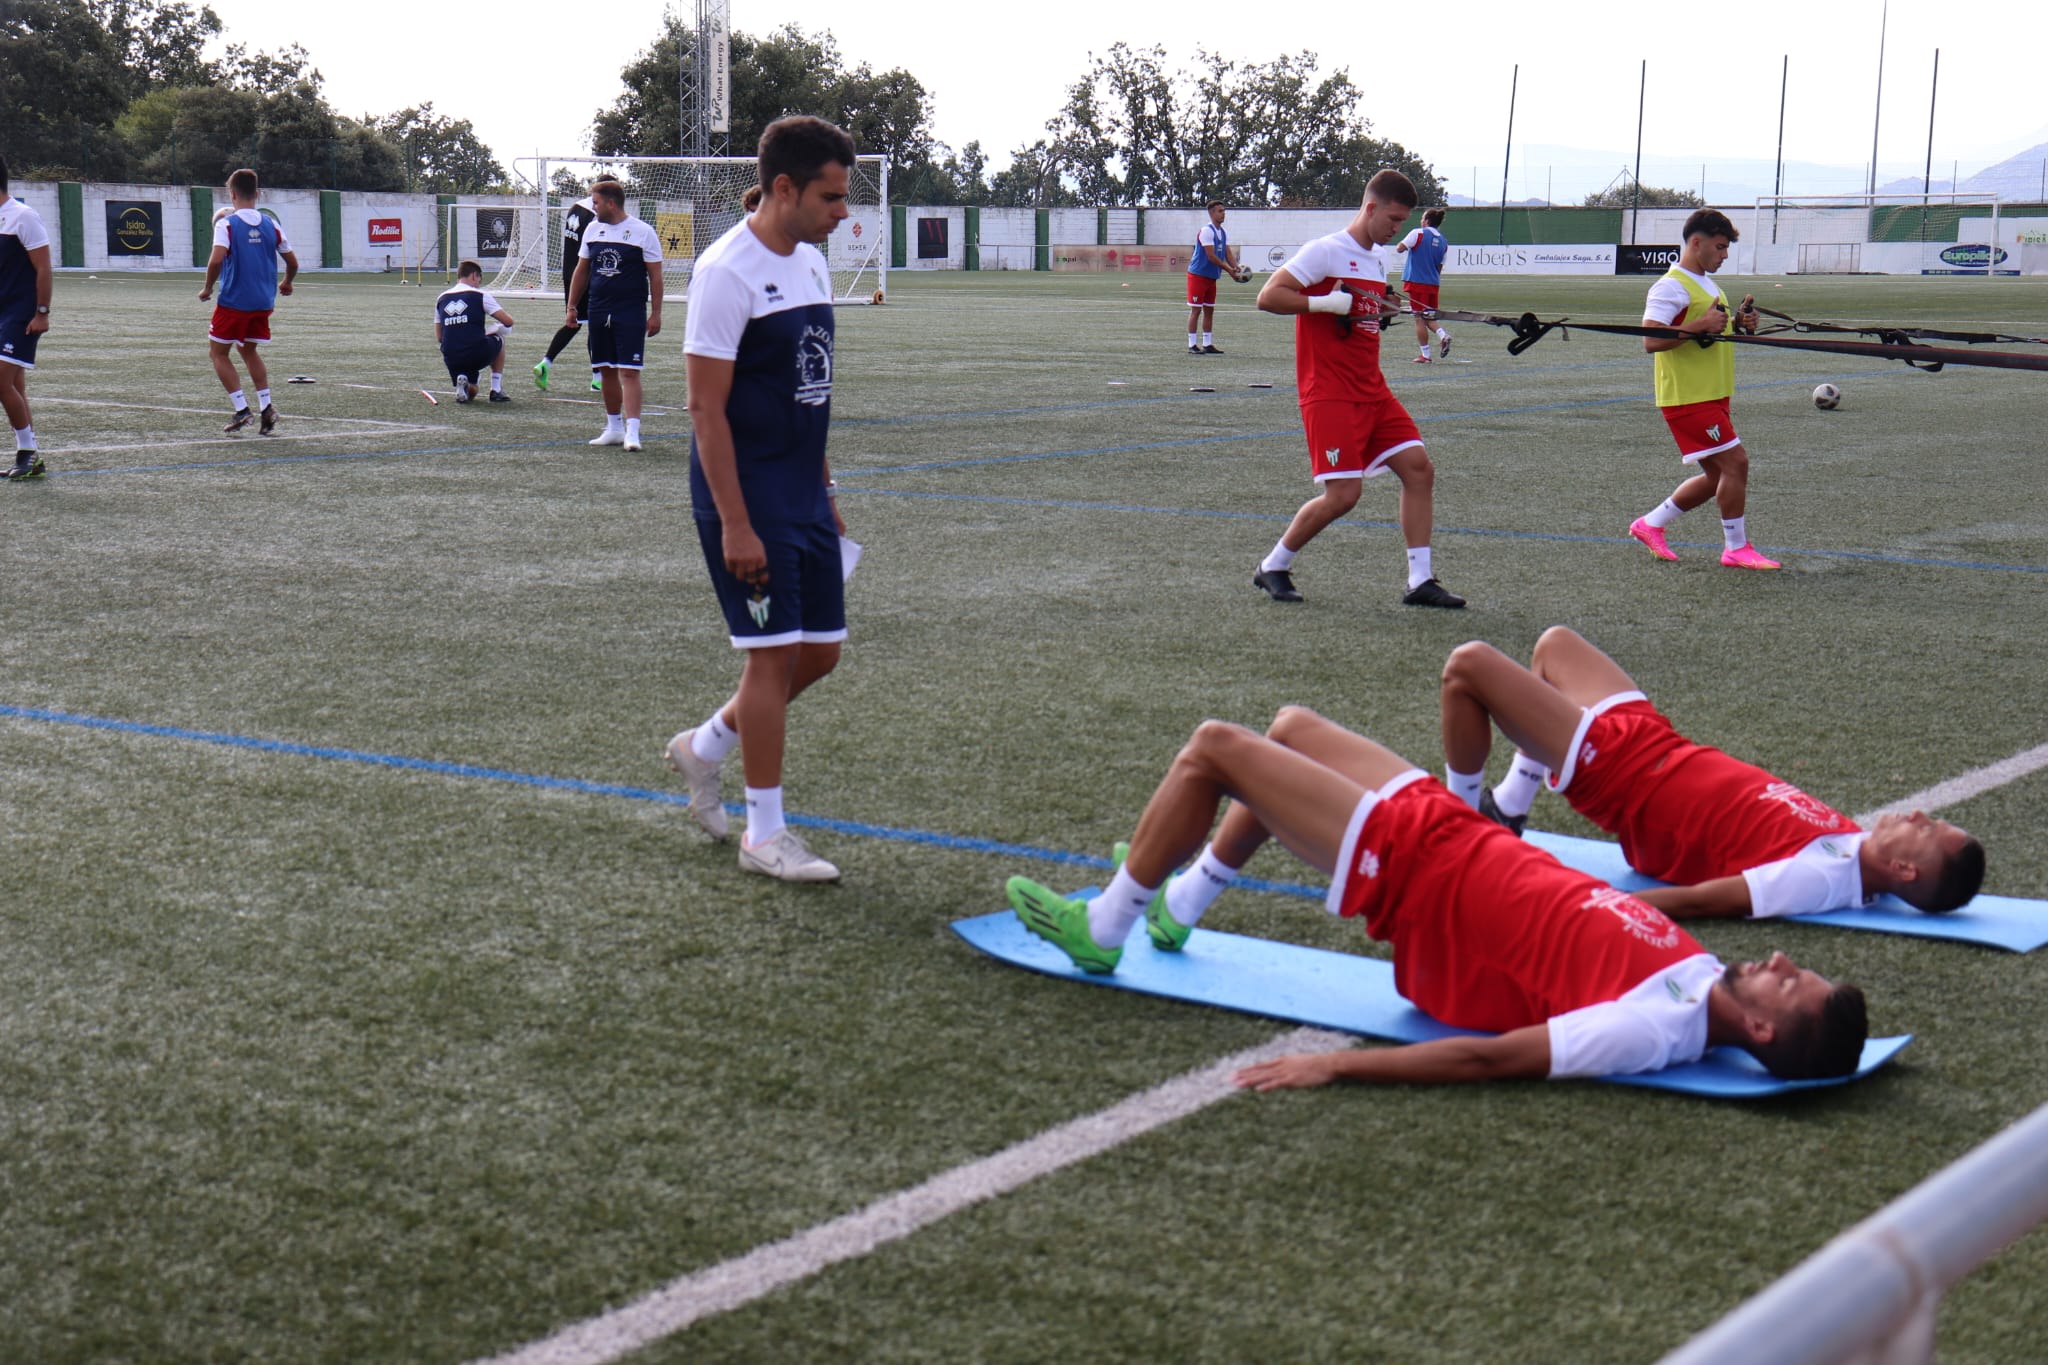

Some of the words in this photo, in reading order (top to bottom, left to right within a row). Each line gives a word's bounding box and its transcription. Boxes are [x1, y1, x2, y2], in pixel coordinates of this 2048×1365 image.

[717, 41, 725, 73] Energy
[126, 220, 146, 230] Isidro
[371, 224, 401, 235] Rodilla
[1457, 248, 1527, 266] Ruben'S
[444, 314, 468, 326] errea
